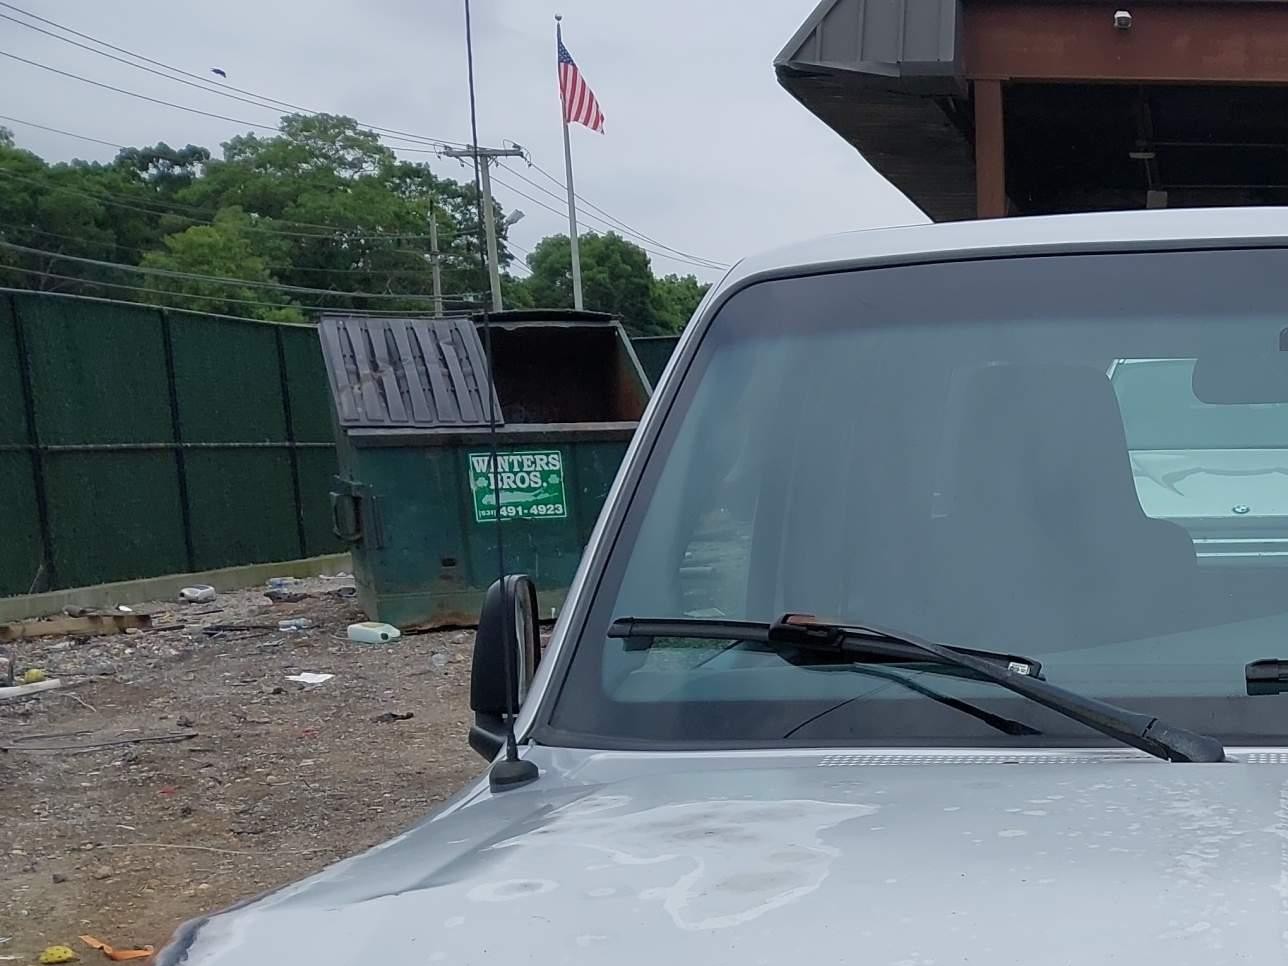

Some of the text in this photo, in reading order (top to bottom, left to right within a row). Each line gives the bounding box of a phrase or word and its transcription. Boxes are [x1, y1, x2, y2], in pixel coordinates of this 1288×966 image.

[472, 453, 561, 473] WINTERS
[487, 471, 548, 489] BROS.
[500, 503, 563, 517] 491-4923
